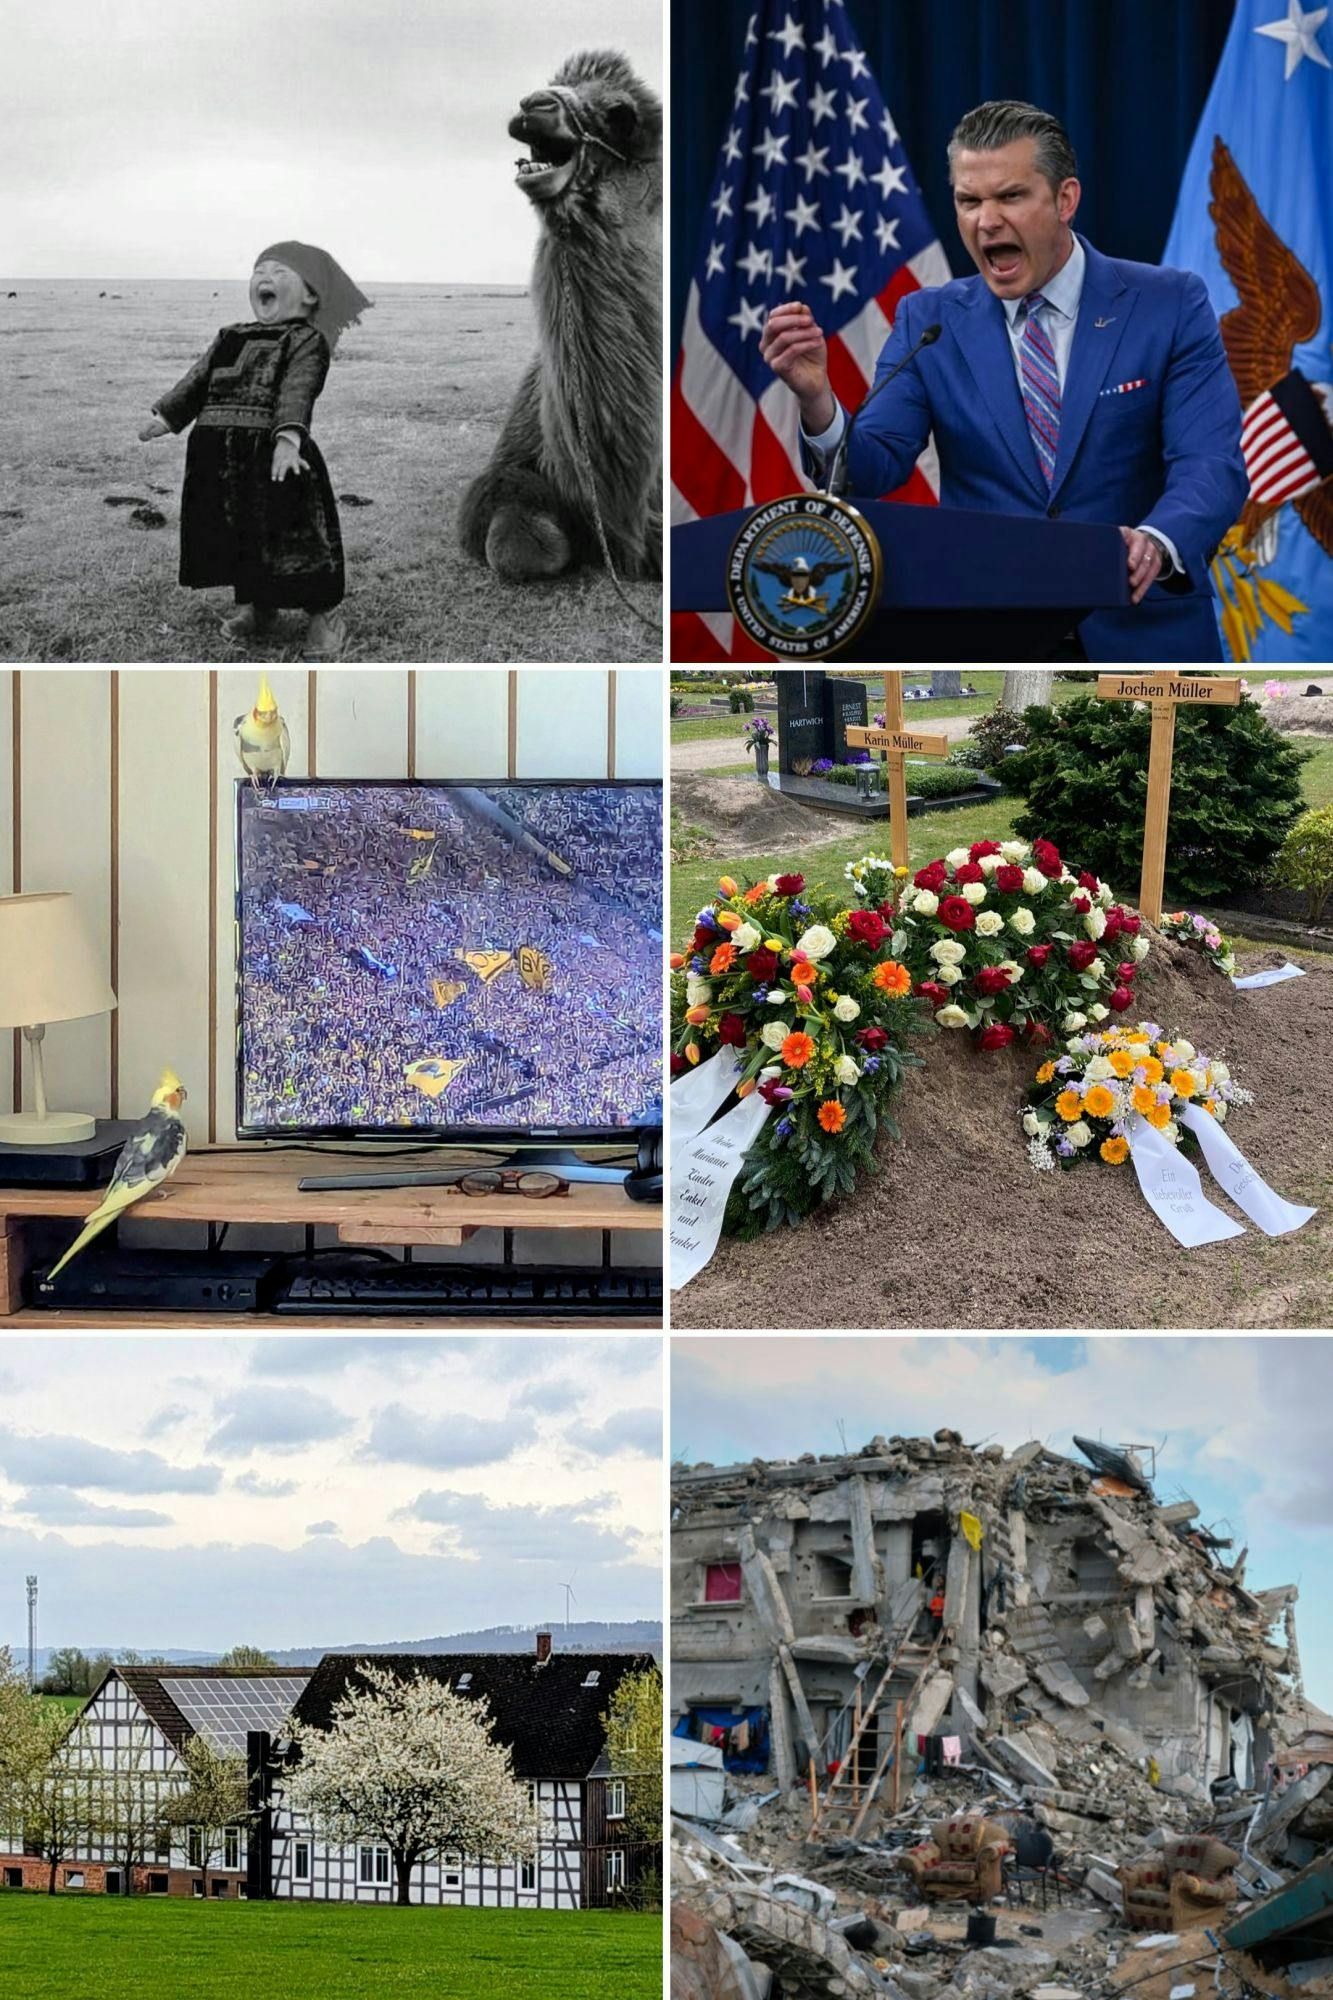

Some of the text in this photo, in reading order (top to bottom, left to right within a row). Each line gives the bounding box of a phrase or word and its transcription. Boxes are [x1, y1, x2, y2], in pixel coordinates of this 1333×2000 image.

[730, 500, 872, 580] DEPARTMENT OF DEFENSE
[736, 590, 868, 653] UNITED STATES OF AMERICA
[1117, 681, 1213, 699] Jochen Müller
[789, 717, 824, 728] HARTWICH
[864, 732, 924, 751] Karin Müller
[690, 1148, 730, 1169] Marianne
[687, 1167, 716, 1187] Kinder
[1160, 1168, 1176, 1183] Ein
[679, 1188, 708, 1208] Enkel
[677, 1214, 699, 1227] und
